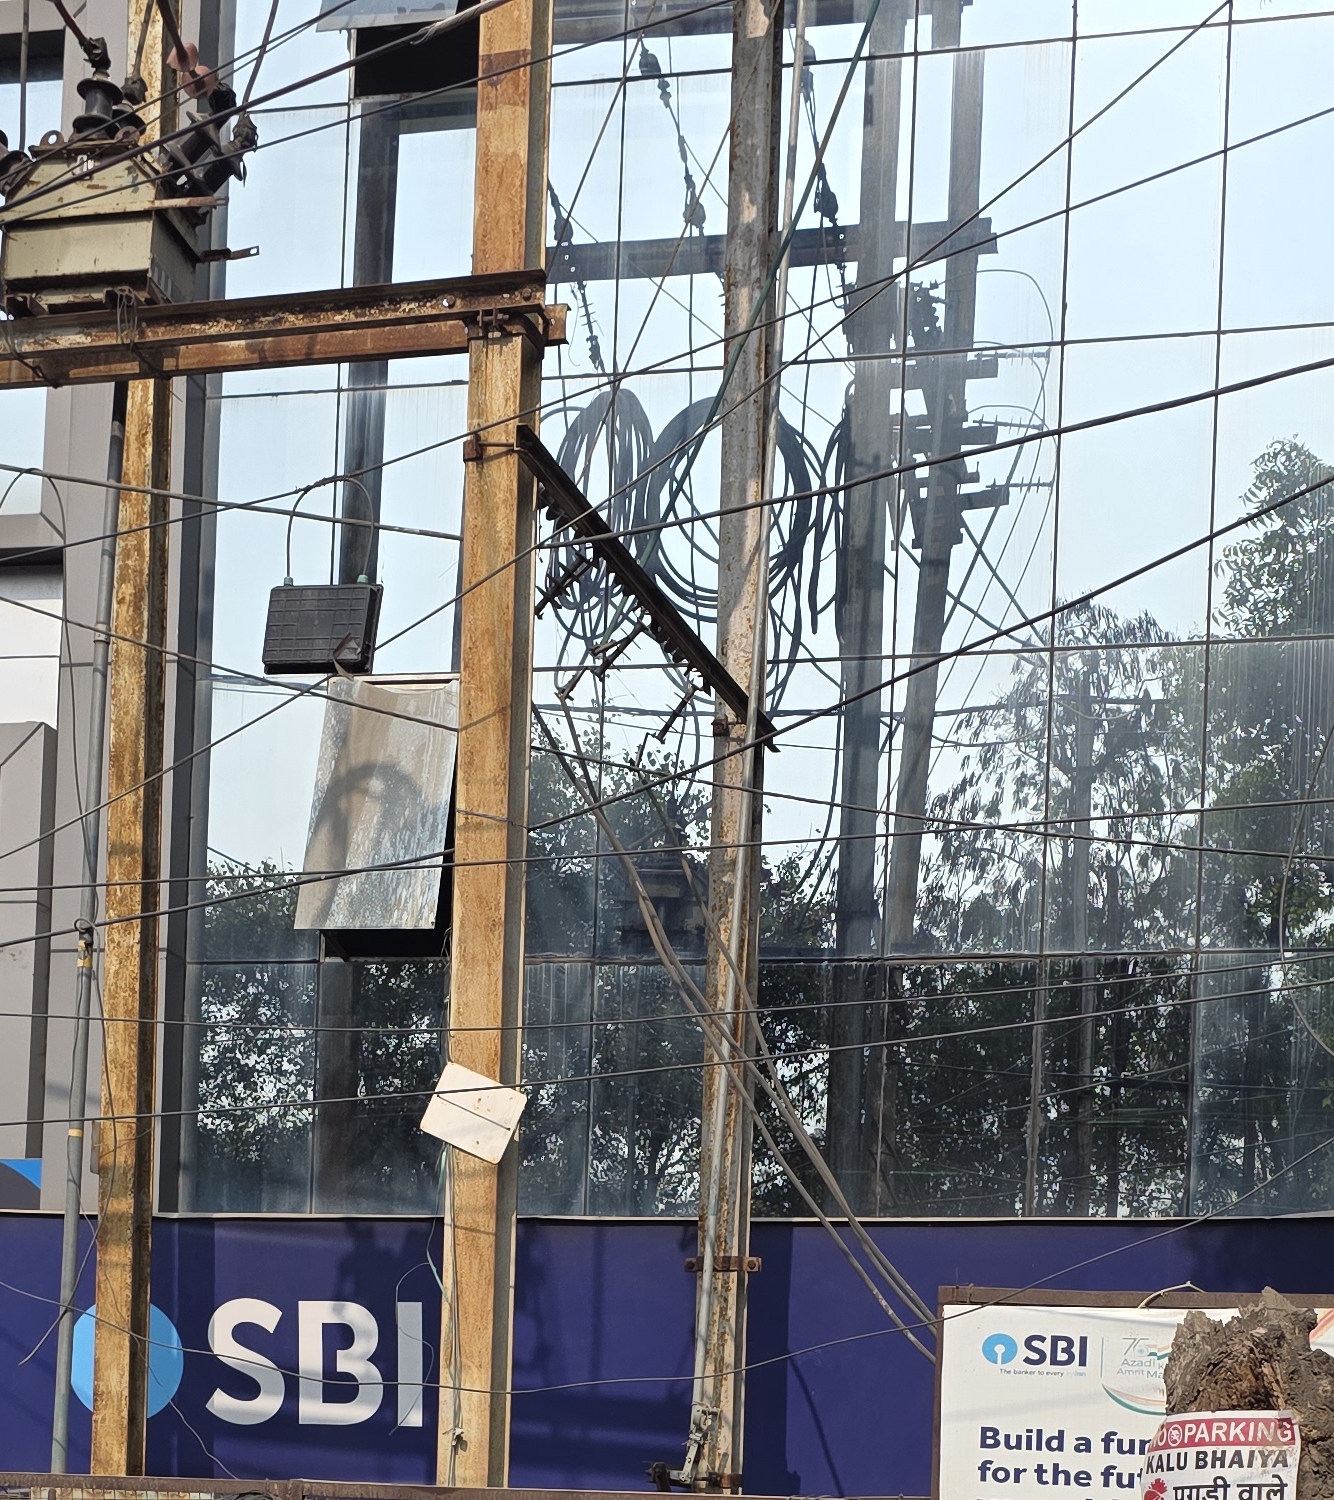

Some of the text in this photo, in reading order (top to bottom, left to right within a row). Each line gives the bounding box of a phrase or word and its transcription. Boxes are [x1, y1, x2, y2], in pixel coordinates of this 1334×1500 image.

[205, 1297, 423, 1428] SBI
[1022, 1334, 1088, 1367] SBI
[1121, 1358, 1156, 1368] Azadi
[1046, 1370, 1065, 1378] every
[1117, 1367, 1145, 1376] Amrit
[980, 1426, 1092, 1454] Build a
[1184, 1421, 1293, 1444] PARKING
[978, 1459, 1092, 1488] for the
[1145, 1449, 1289, 1475] KALU BHAIYA
